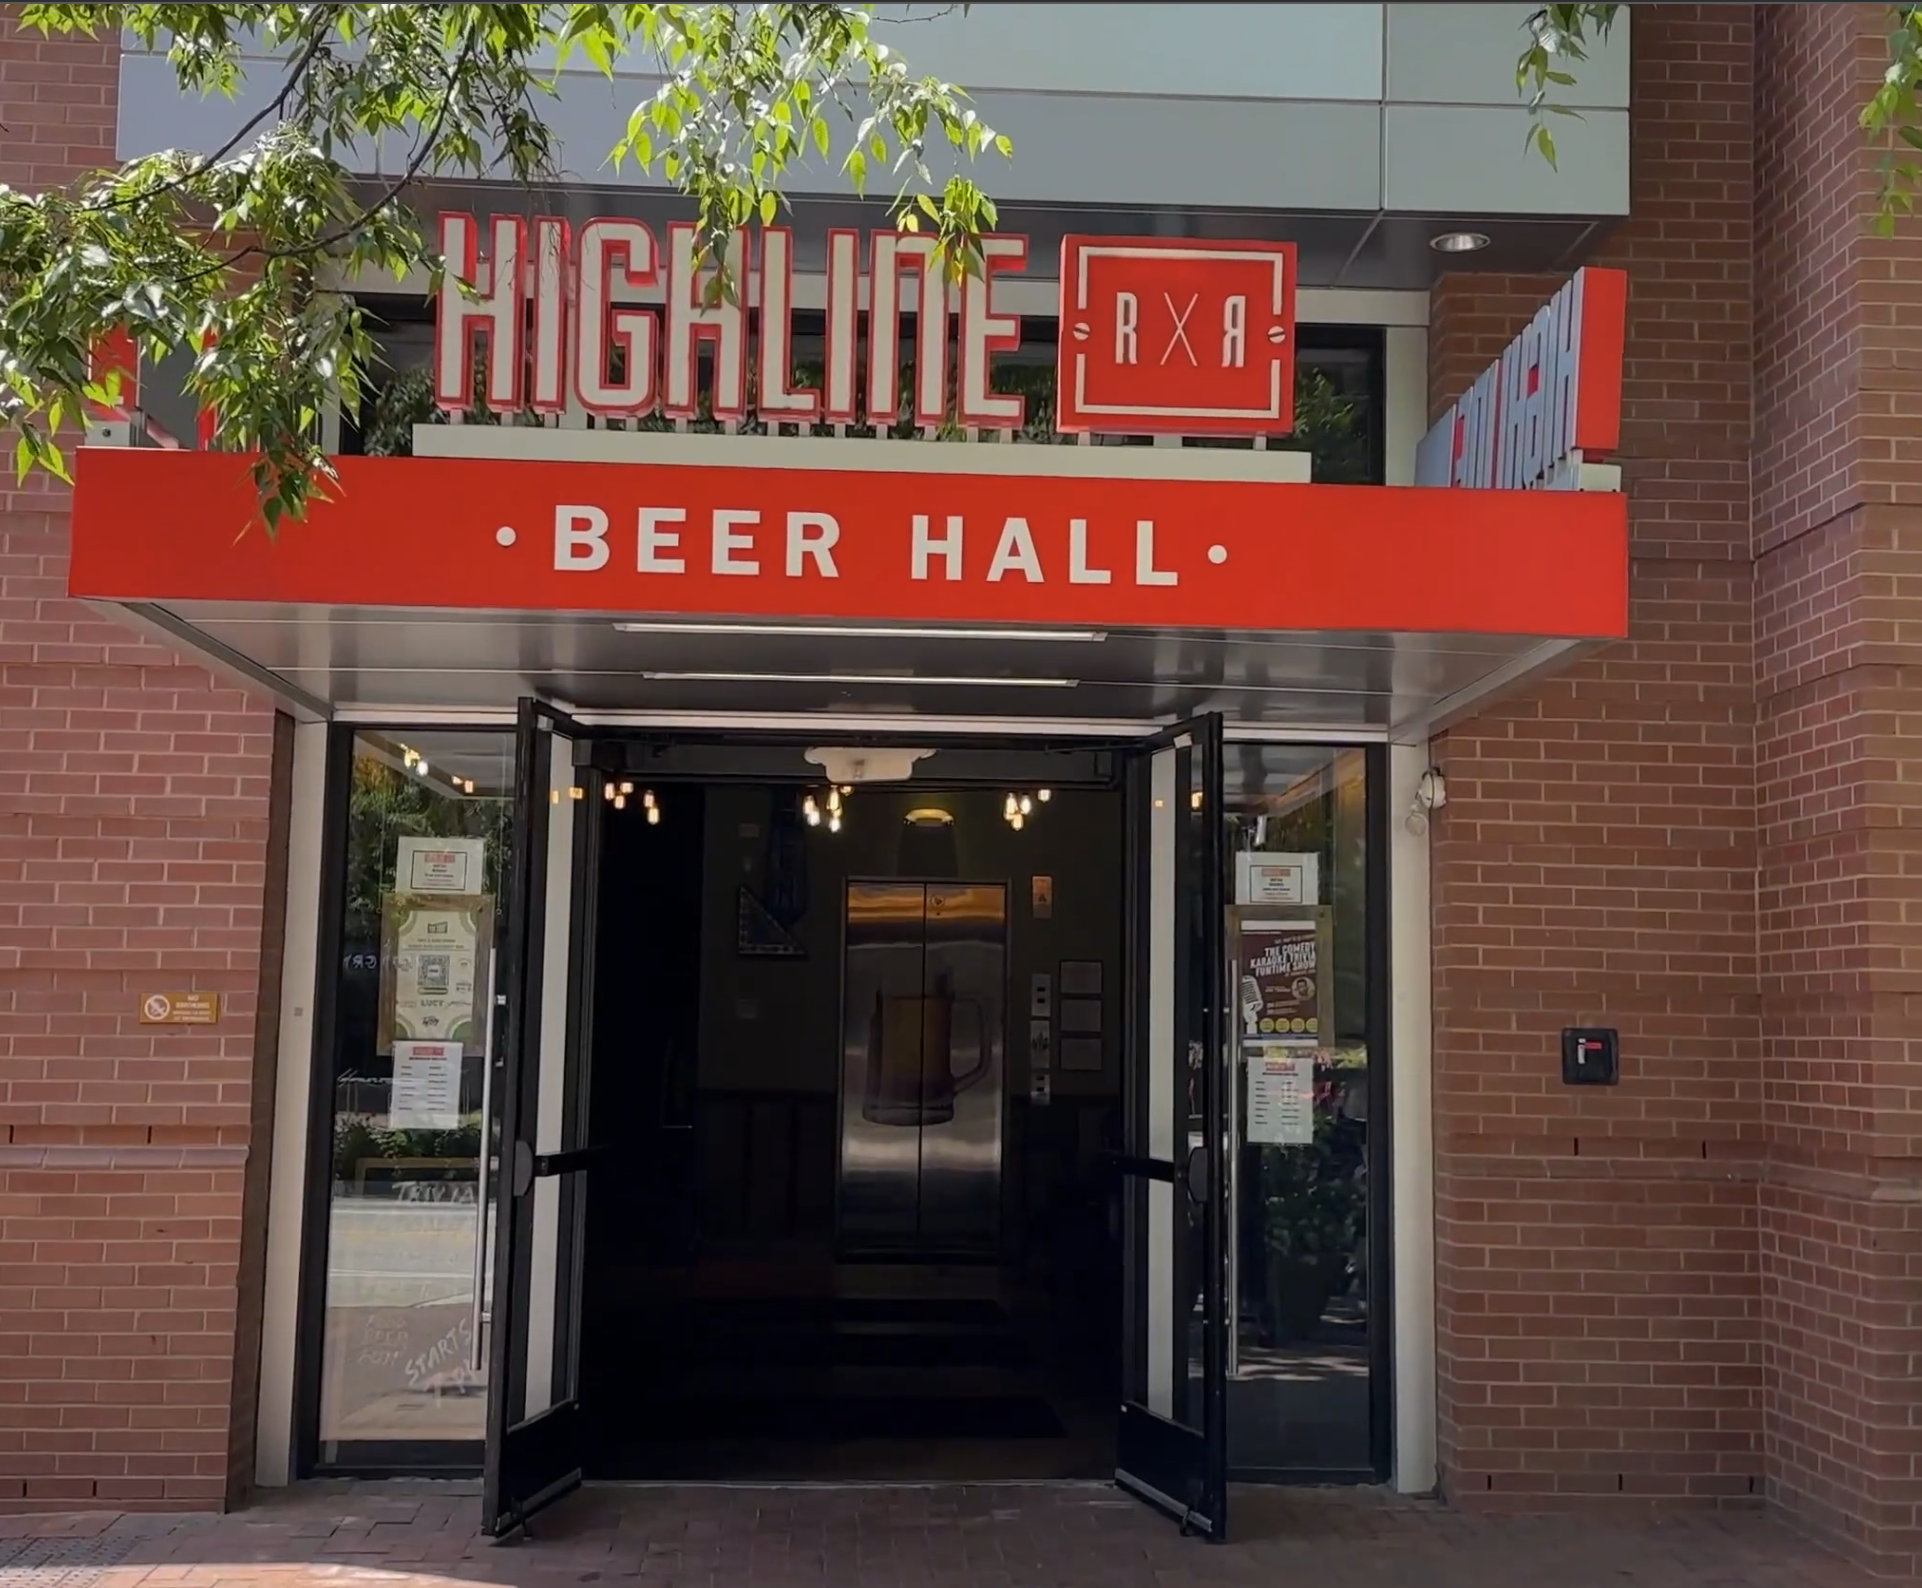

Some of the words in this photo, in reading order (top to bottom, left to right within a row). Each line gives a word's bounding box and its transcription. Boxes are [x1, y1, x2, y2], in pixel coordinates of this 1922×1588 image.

[434, 211, 1028, 428] HIGHLINE
[553, 504, 841, 579] BEER
[910, 514, 1180, 587] HALL
[405, 1318, 471, 1387] STARTS
